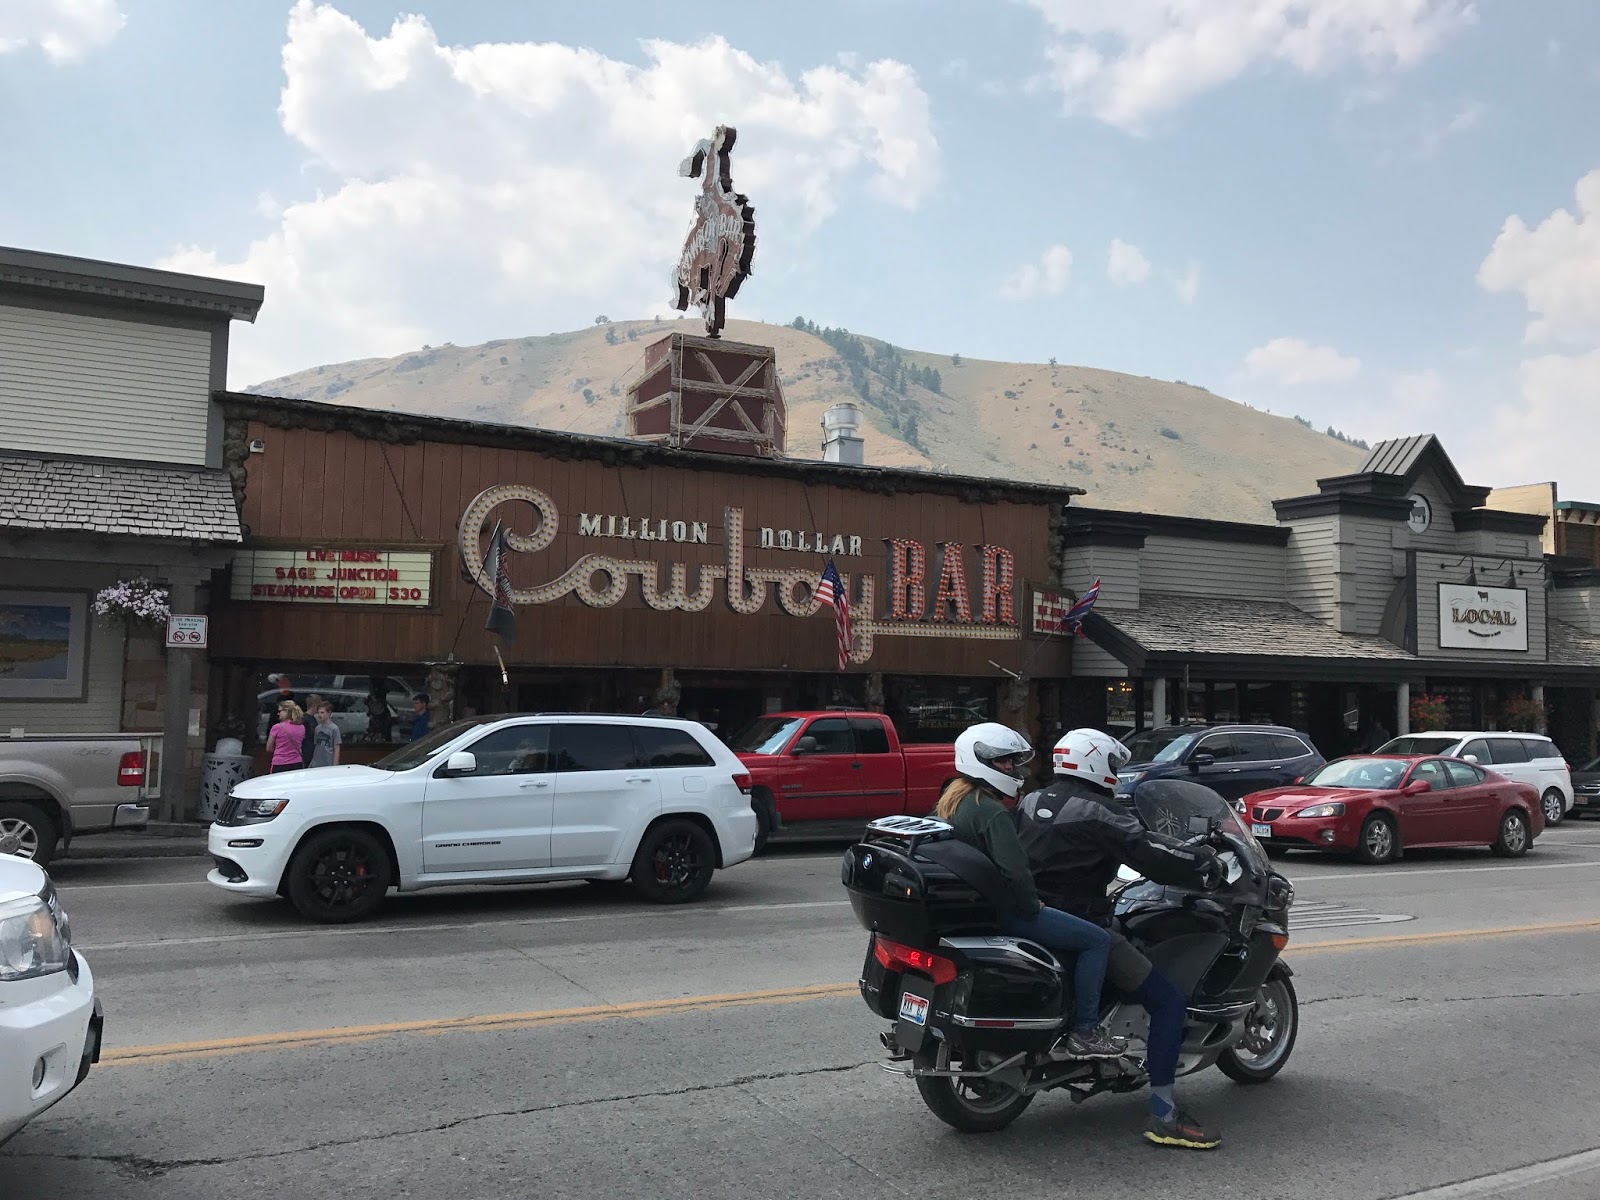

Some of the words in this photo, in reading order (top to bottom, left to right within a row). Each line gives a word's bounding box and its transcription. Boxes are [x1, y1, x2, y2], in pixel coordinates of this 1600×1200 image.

[579, 512, 708, 544] MILLION
[761, 526, 862, 556] DOLLAR
[306, 550, 335, 562] LIVE
[341, 551, 381, 563] MUSIC
[275, 567, 316, 579] SAGE
[326, 568, 399, 581] JUNCTION
[458, 484, 875, 664] Cowboy
[882, 537, 1018, 625] BAR
[253, 584, 335, 598] STEAKHOUSE
[339, 586, 375, 599] OPEN
[389, 587, 421, 600] 530
[1452, 607, 1517, 626] LOCAL
